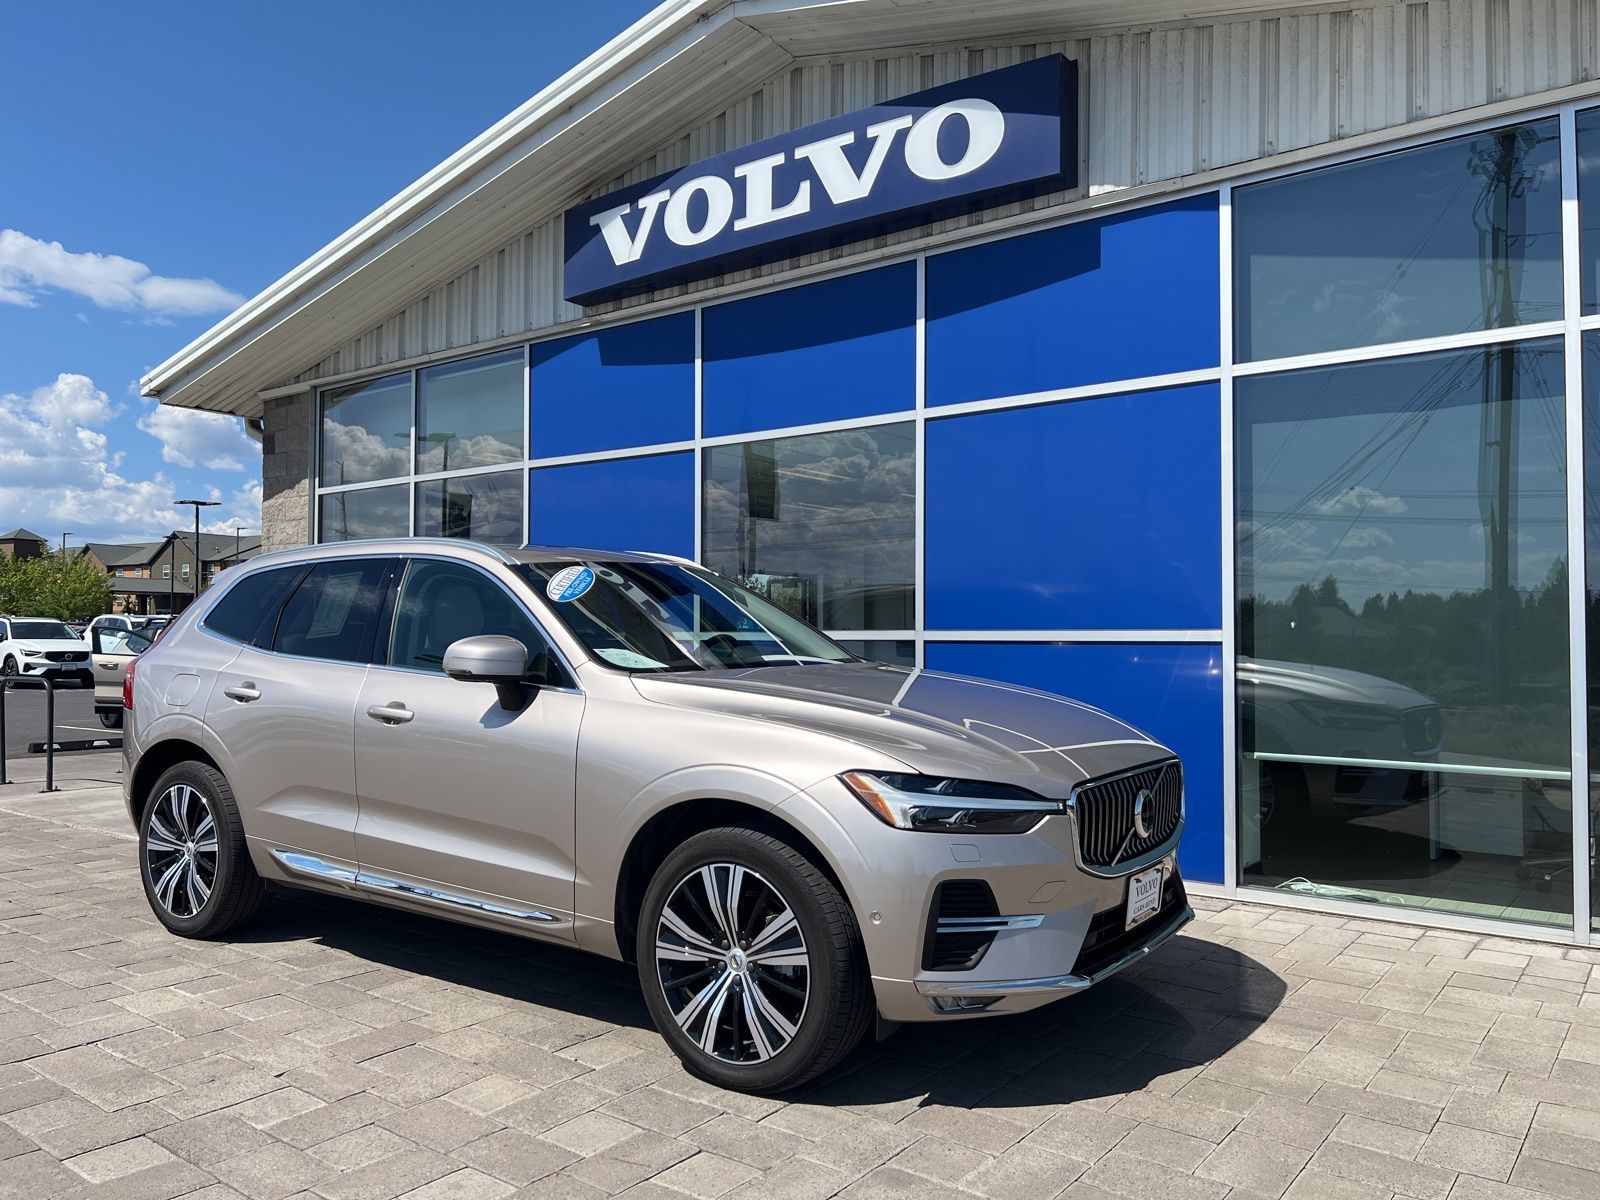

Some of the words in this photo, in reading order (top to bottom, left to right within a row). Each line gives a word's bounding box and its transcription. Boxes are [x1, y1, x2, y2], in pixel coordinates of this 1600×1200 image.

[590, 98, 1005, 266] VOLVO
[550, 568, 581, 595] CERTIFIED
[563, 572, 588, 596] PRE-OWNED
[1135, 877, 1158, 897] VOLVO
